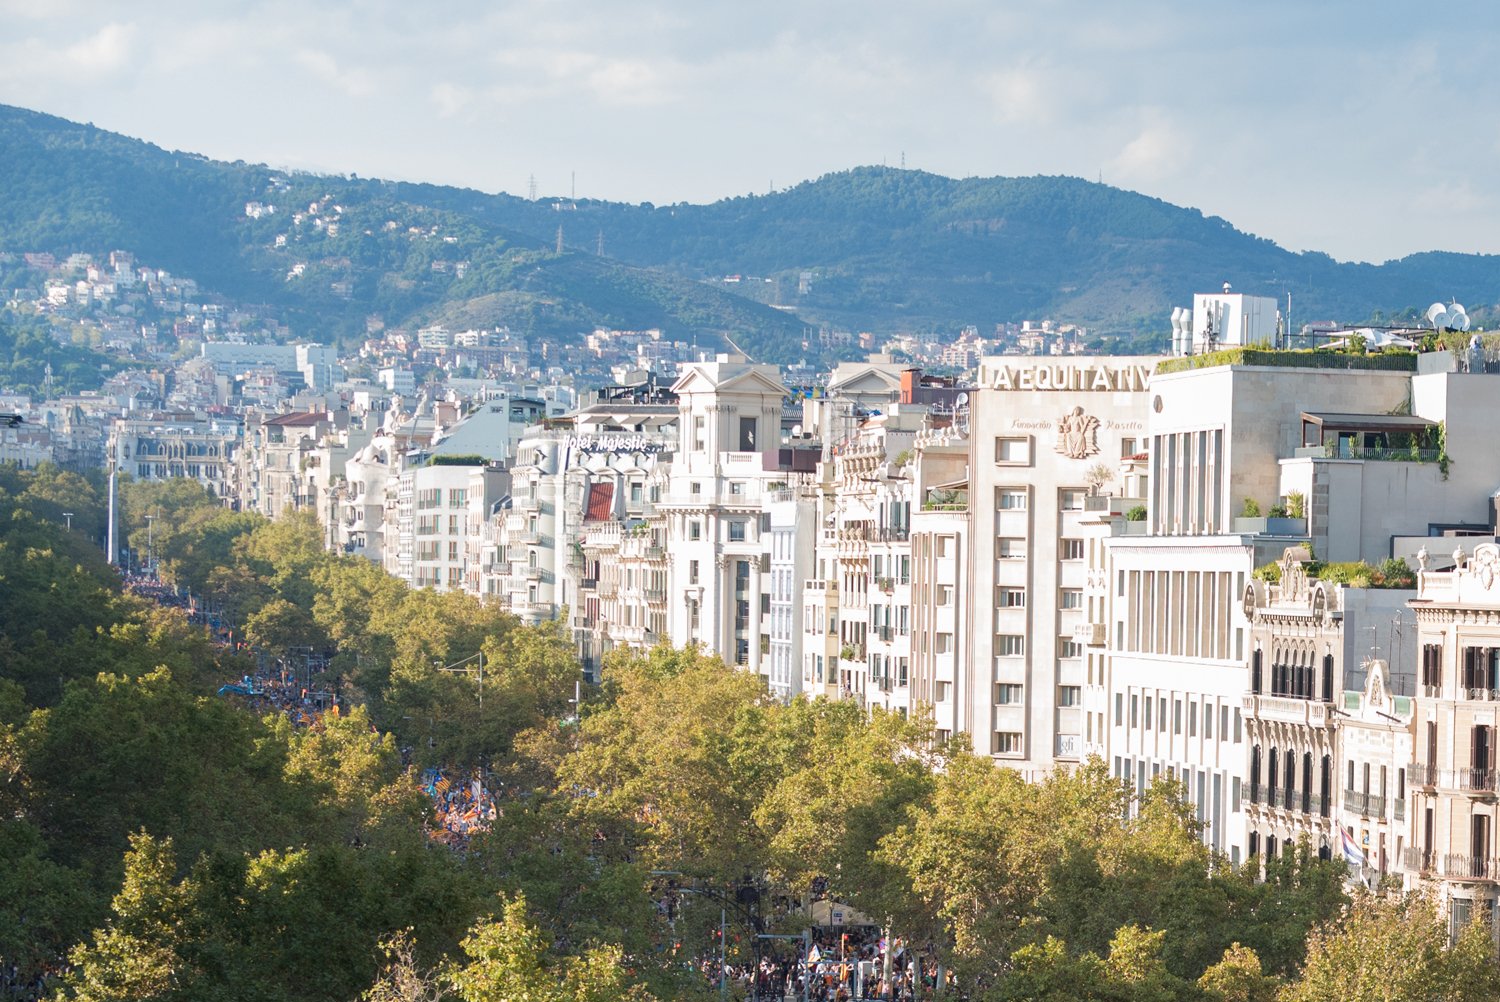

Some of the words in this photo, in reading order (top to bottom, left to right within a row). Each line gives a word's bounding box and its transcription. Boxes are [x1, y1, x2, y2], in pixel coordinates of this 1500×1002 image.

[977, 364, 1012, 389] LA
[1018, 364, 1151, 389] EQUITATIV
[562, 434, 592, 449] Hotel
[595, 434, 647, 450] Majestic
